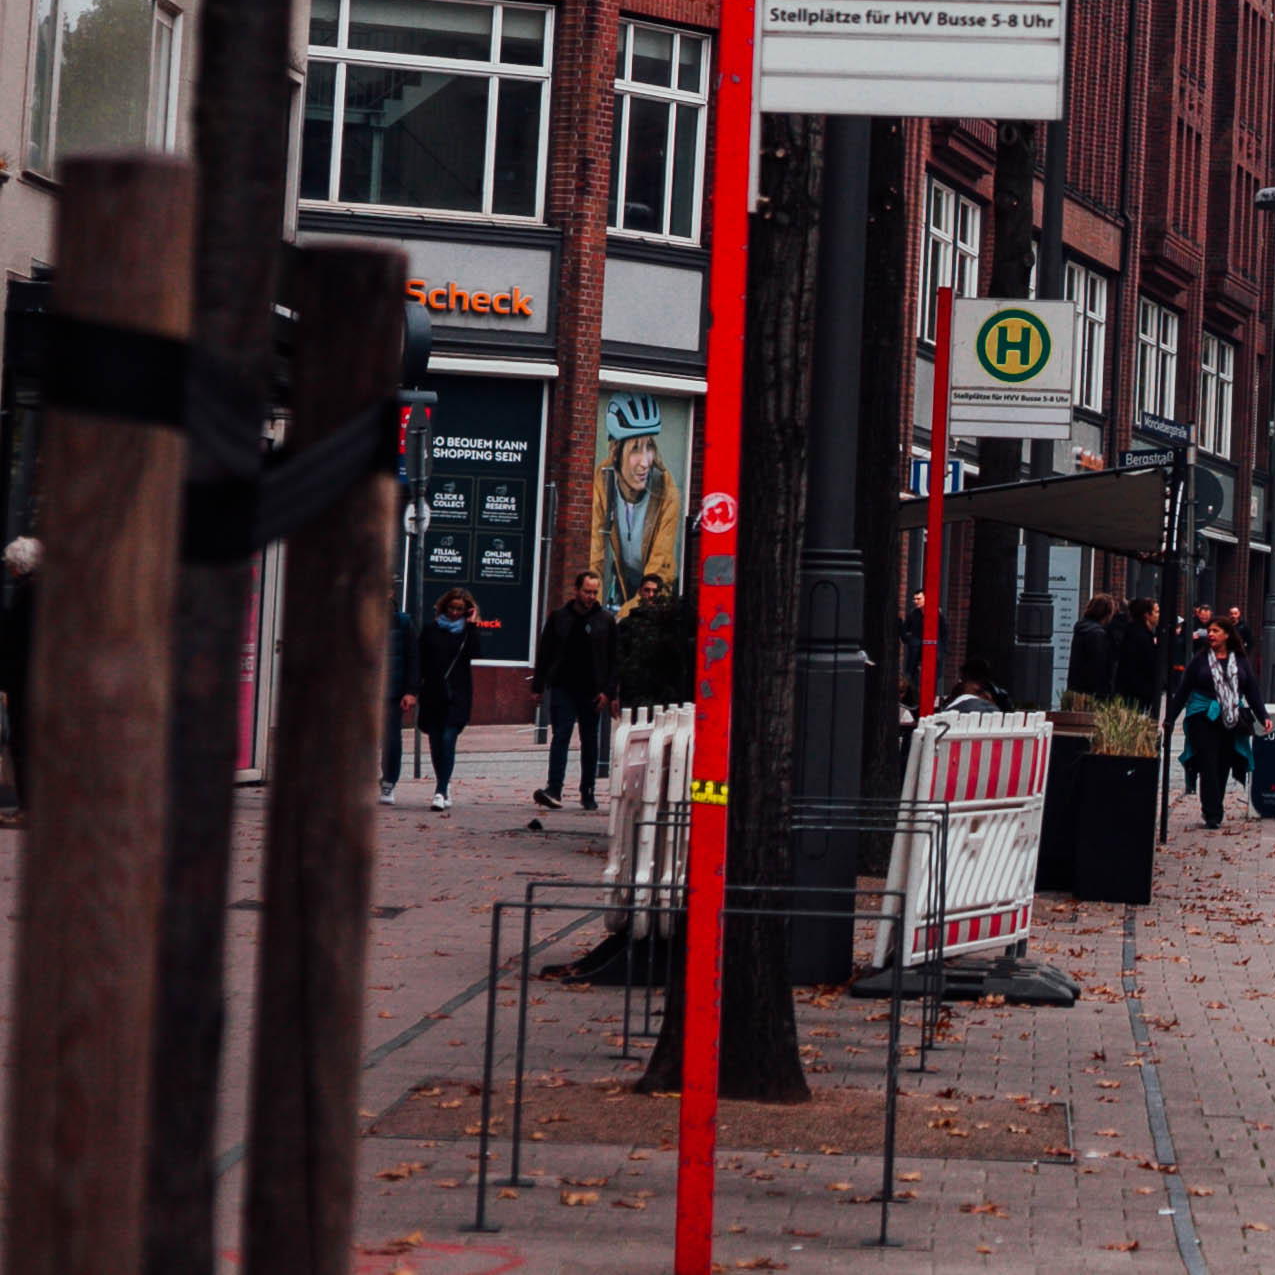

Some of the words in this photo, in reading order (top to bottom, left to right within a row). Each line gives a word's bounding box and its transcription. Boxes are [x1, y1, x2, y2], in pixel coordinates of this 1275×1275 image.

[770, 8, 861, 25] Stellplätze
[866, 10, 890, 24] für
[895, 12, 932, 25] HVV
[937, 13, 985, 27] Busse
[991, 14, 1017, 28] 5-8
[1023, 14, 1054, 28] Uhr
[404, 278, 533, 317] Scheck
[996, 326, 1032, 366] H
[447, 437, 492, 449] BEQUEM
[495, 440, 528, 451] KANN
[433, 448, 493, 461] SHOPPING
[495, 451, 522, 462] SEIN
[433, 500, 465, 508] COLLECT
